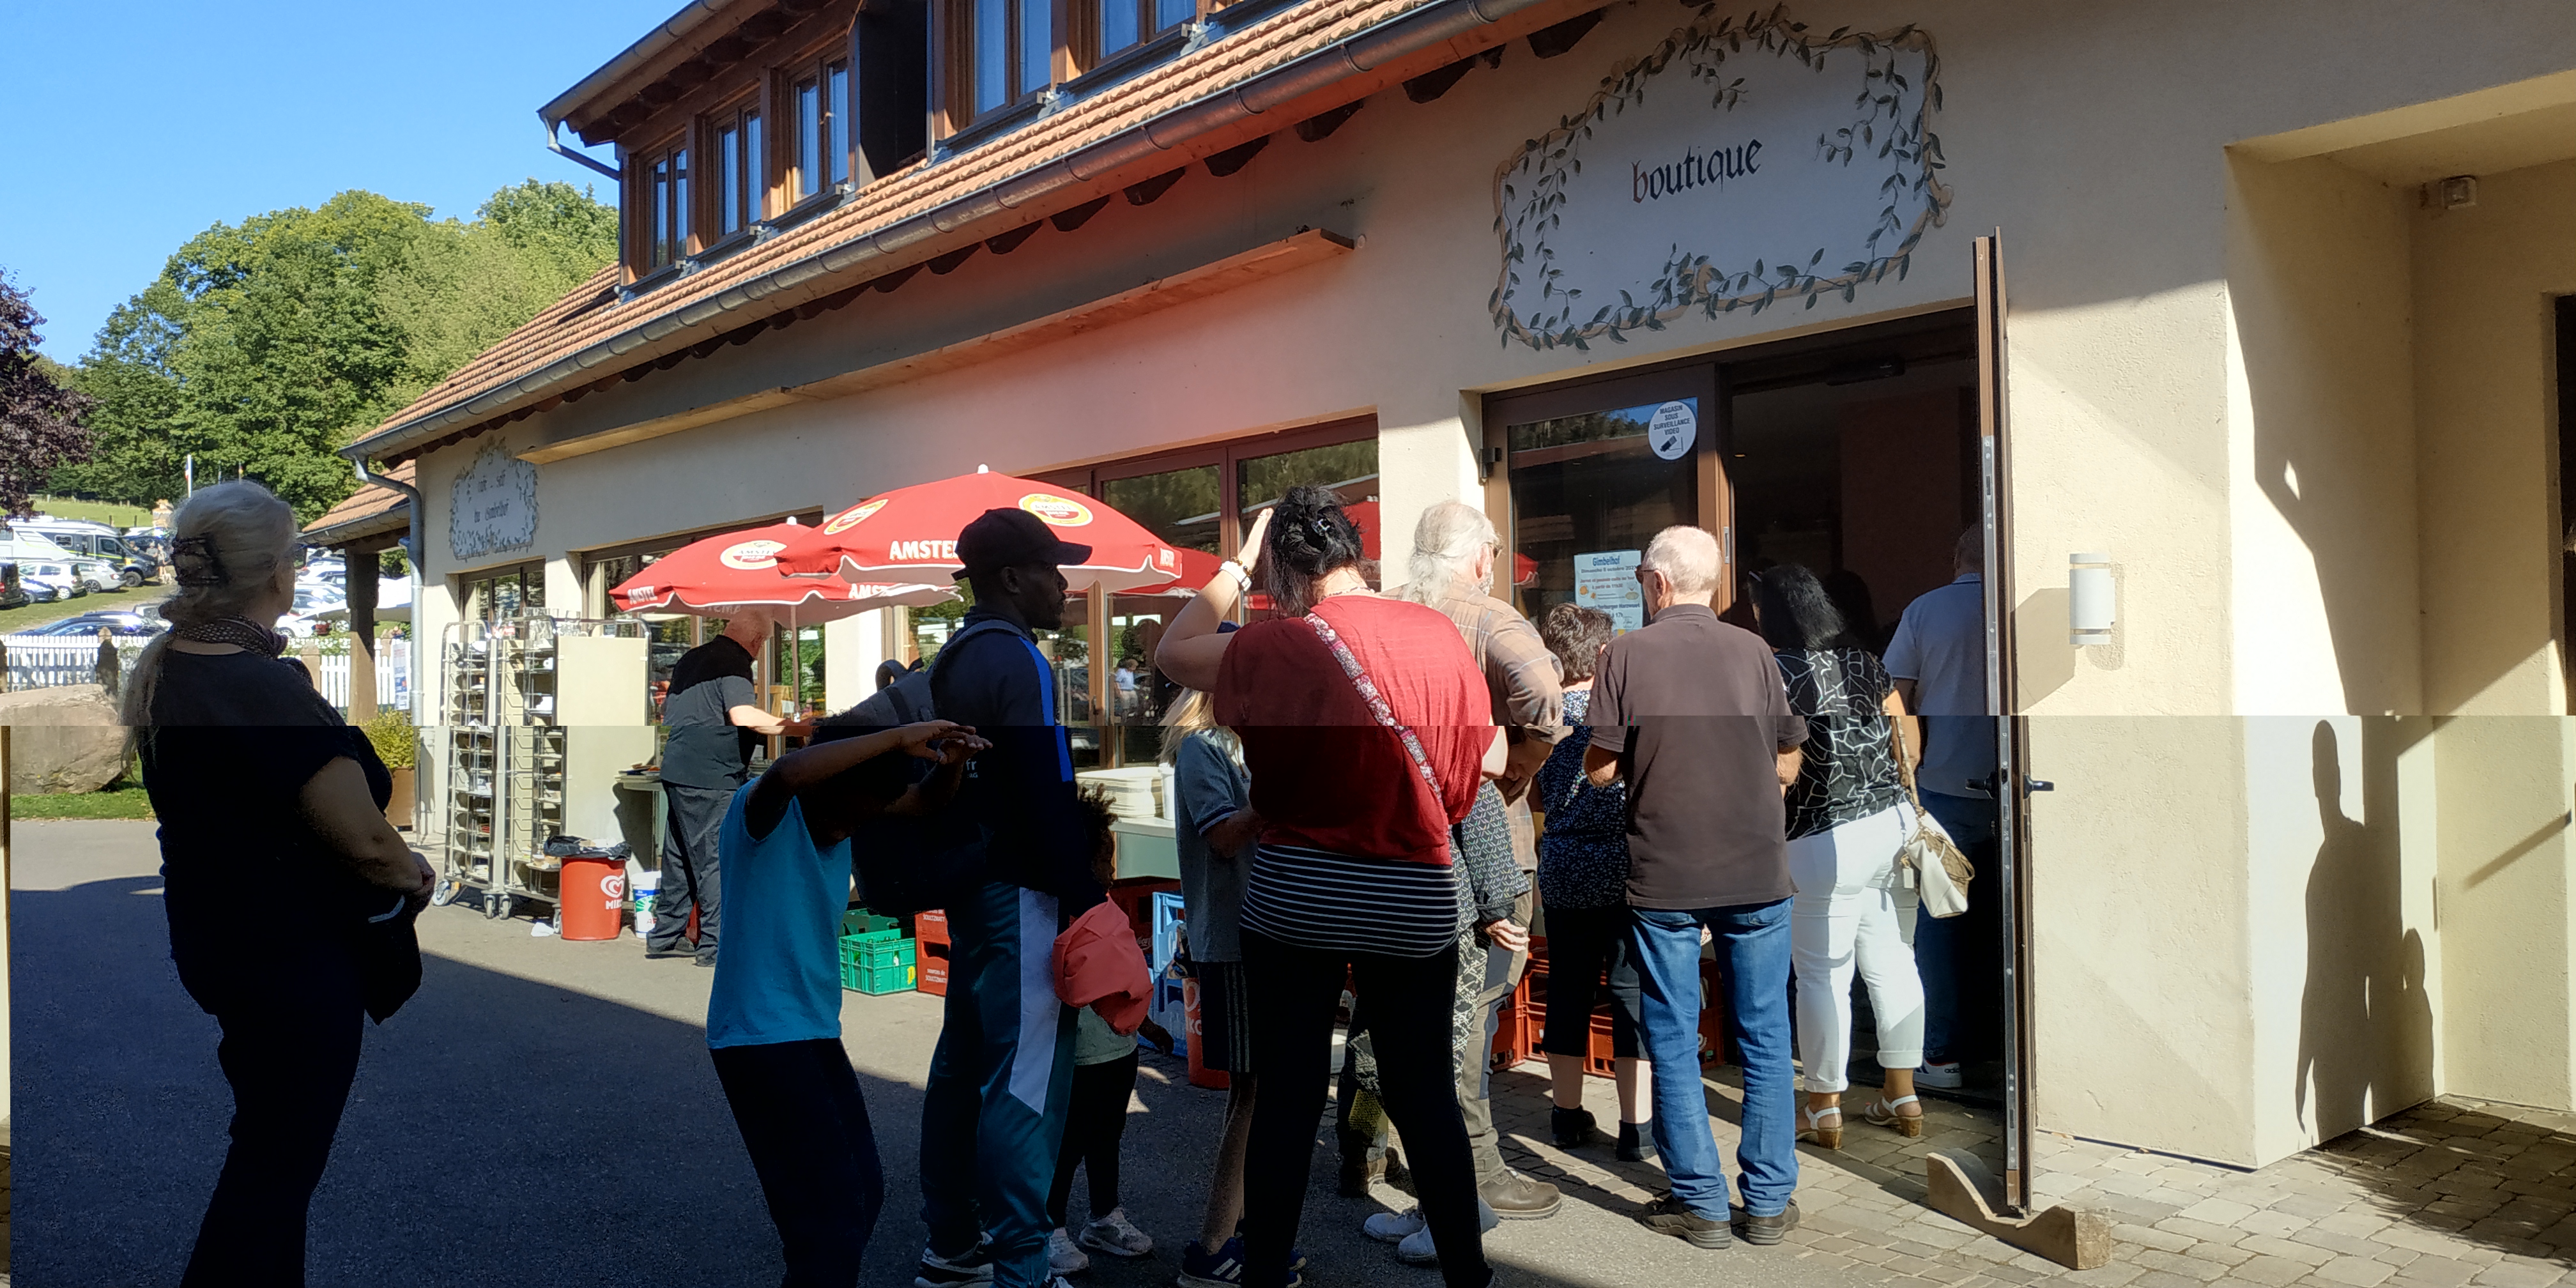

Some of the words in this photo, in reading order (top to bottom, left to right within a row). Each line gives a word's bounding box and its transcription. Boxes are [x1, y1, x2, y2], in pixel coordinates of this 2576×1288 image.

[1631, 138, 1763, 204] boutique
[1660, 404, 1683, 414] MAGASIN
[1664, 413, 1678, 421] SOUS
[1653, 417, 1690, 431] SURVEILLANCE
[1664, 427, 1680, 435] VIDEO
